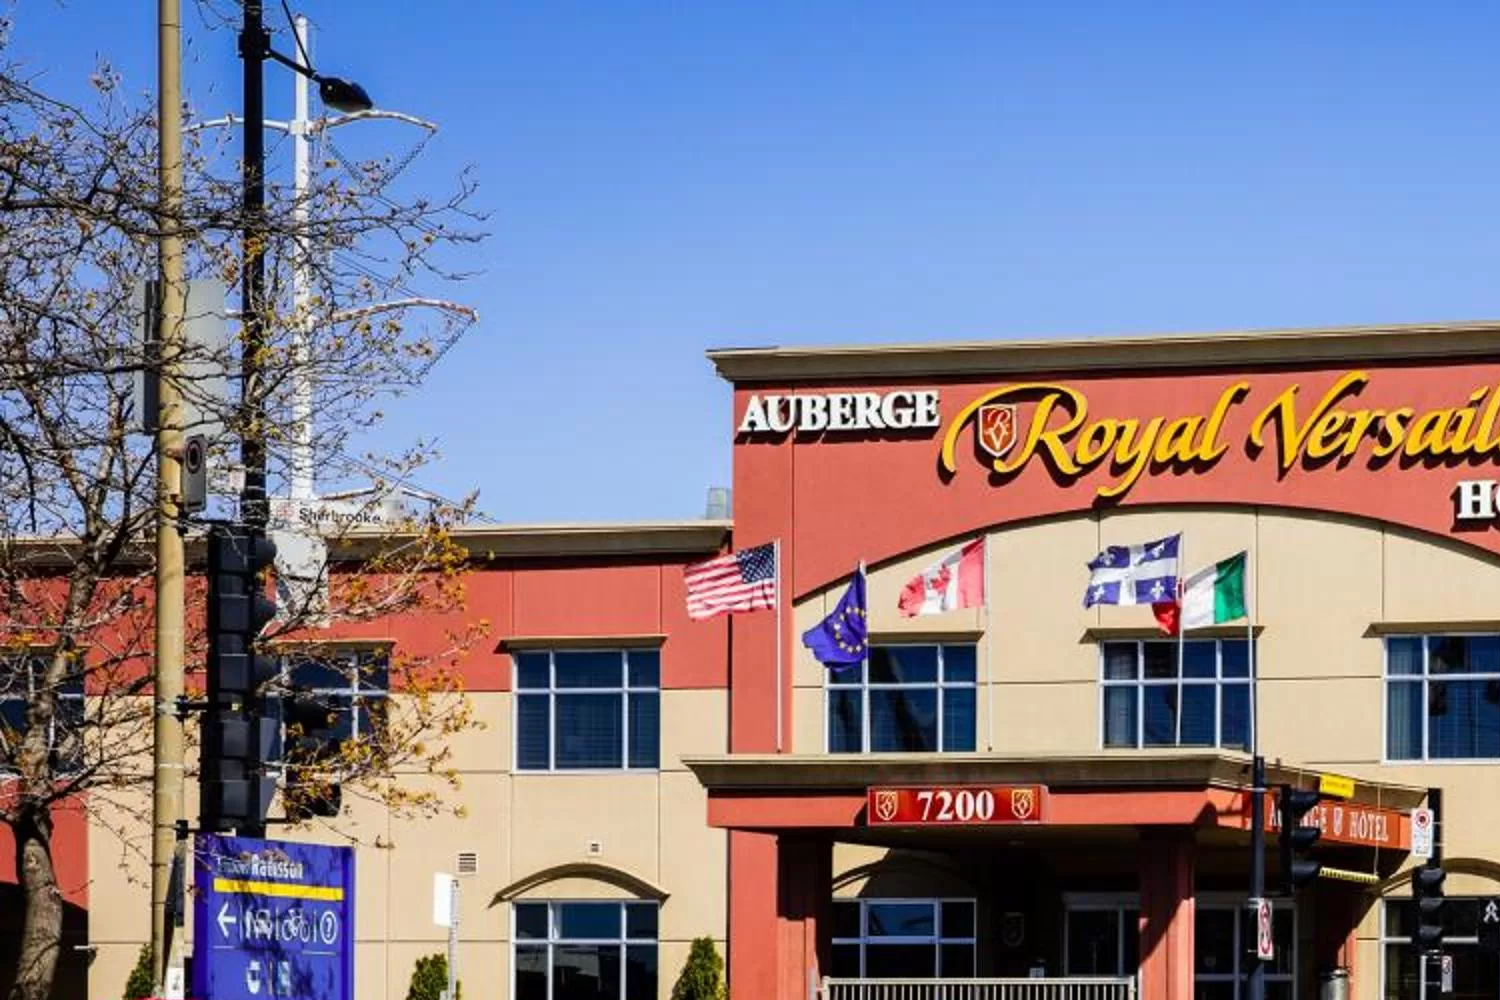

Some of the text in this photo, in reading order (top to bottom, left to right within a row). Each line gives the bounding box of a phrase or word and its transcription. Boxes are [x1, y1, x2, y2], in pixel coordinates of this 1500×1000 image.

[738, 391, 941, 432] AUBERGE
[942, 379, 1249, 497] Royal
[917, 790, 995, 821] 7200
